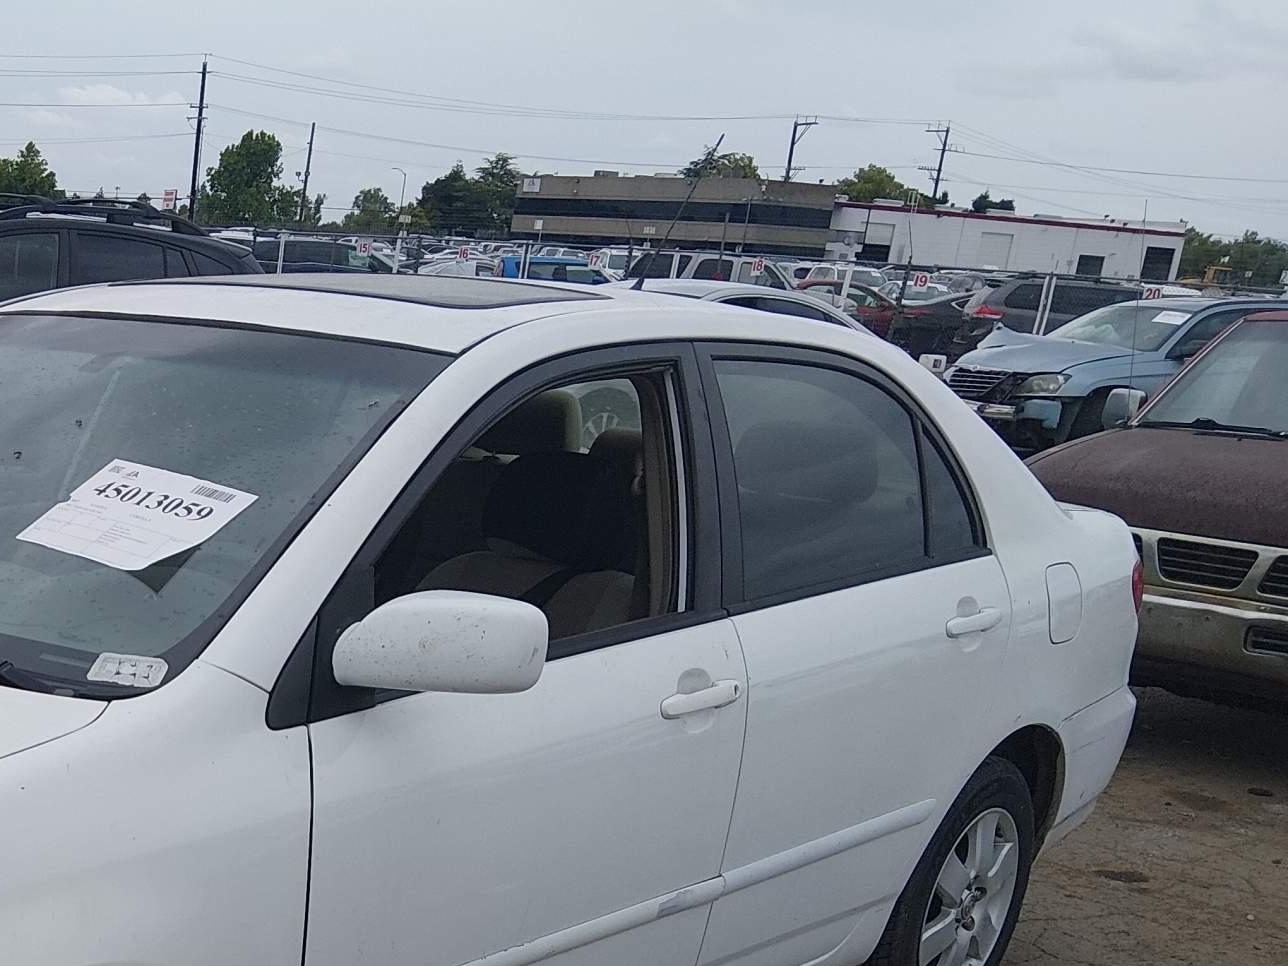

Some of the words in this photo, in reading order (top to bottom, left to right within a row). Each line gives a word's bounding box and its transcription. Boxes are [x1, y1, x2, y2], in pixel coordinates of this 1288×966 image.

[359, 242, 368, 254] 15
[458, 248, 469, 259] 16
[589, 254, 601, 266] 17
[752, 259, 764, 272] 18
[913, 274, 929, 288] 19
[1145, 287, 1161, 299] 20
[93, 480, 214, 521] 45013059
